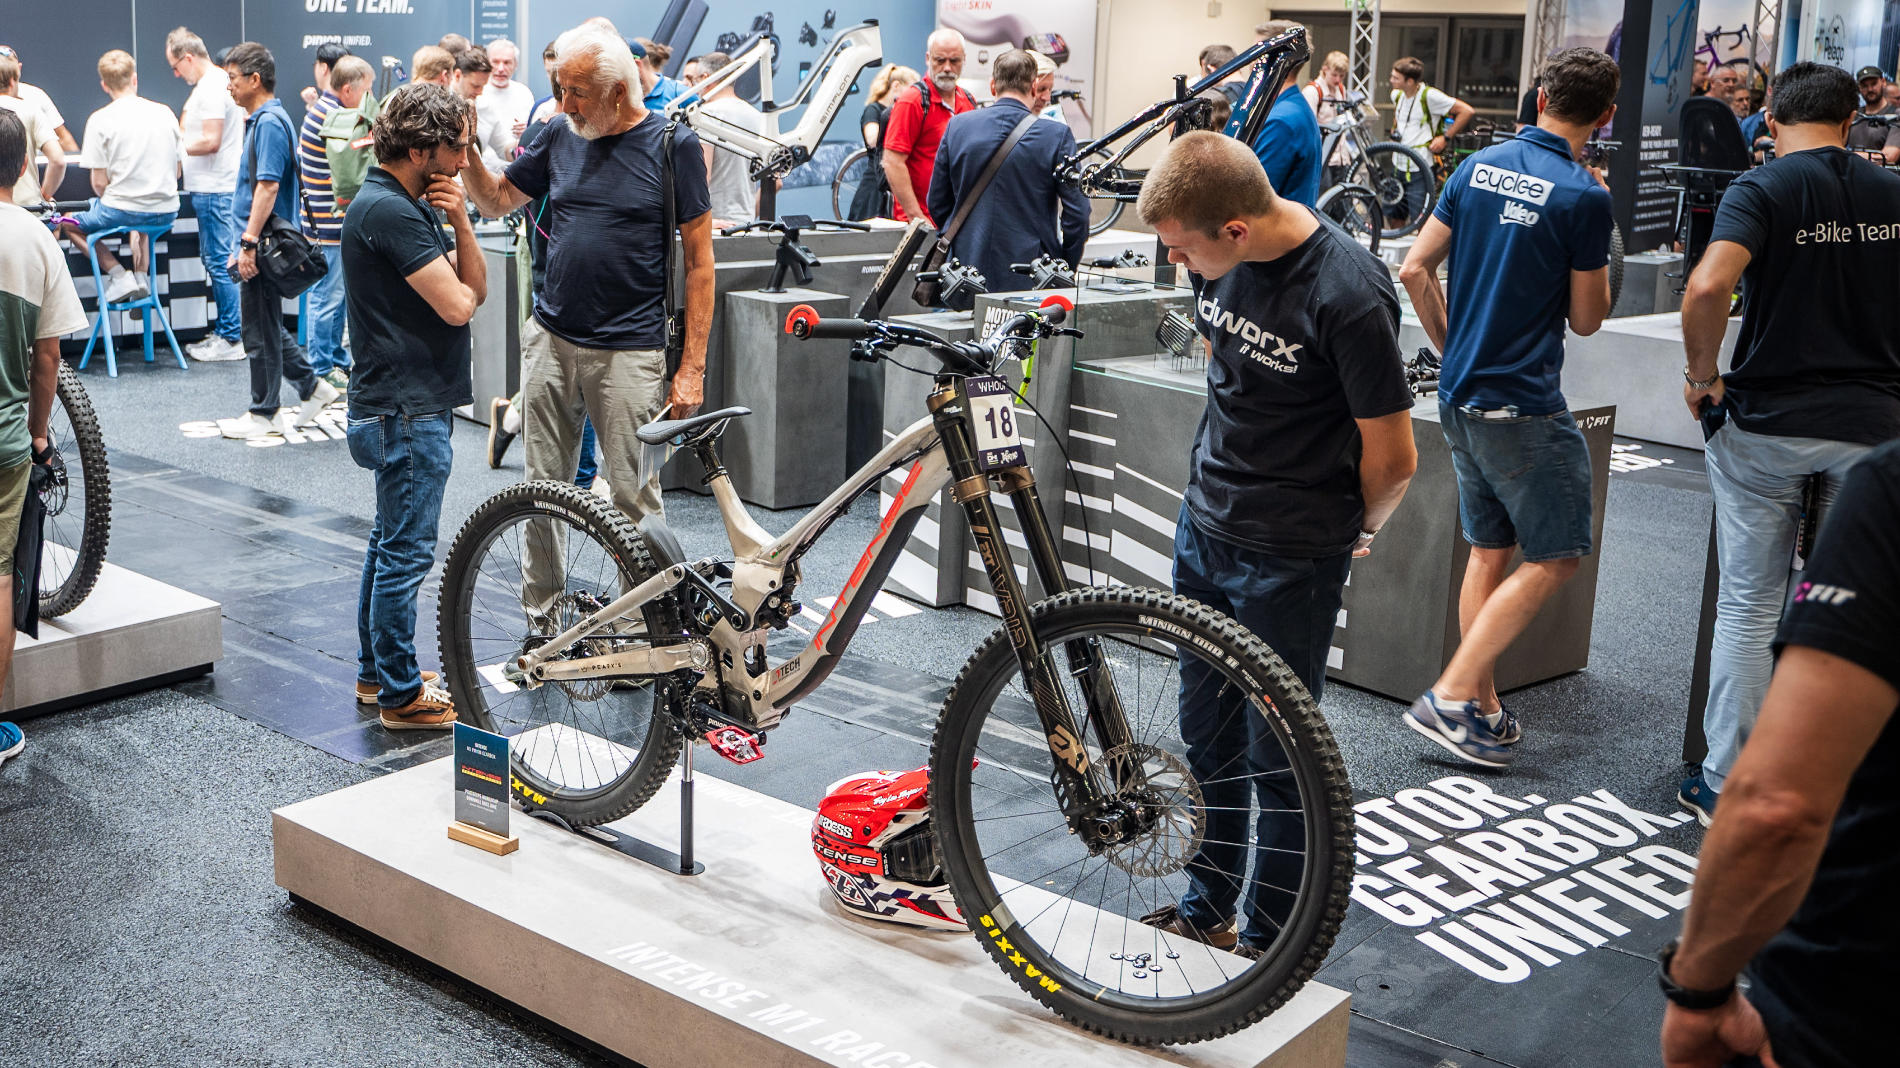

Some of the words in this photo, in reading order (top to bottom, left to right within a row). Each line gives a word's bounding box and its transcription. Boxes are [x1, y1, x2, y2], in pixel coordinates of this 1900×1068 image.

[1475, 168, 1544, 198] cyclee
[1795, 220, 1852, 245] e-Bike
[1239, 342, 1251, 354] it
[1250, 349, 1299, 374] works!
[984, 405, 1013, 439] 18
[814, 460, 924, 651] INTENSE
[1138, 614, 1193, 640] MINION
[1353, 776, 1549, 866] OTOR.
[1350, 788, 1696, 927] GEARBOX.
[980, 915, 1062, 993] MAXXIS
[607, 941, 769, 1009] INTENSE
[750, 1002, 826, 1034] M1
